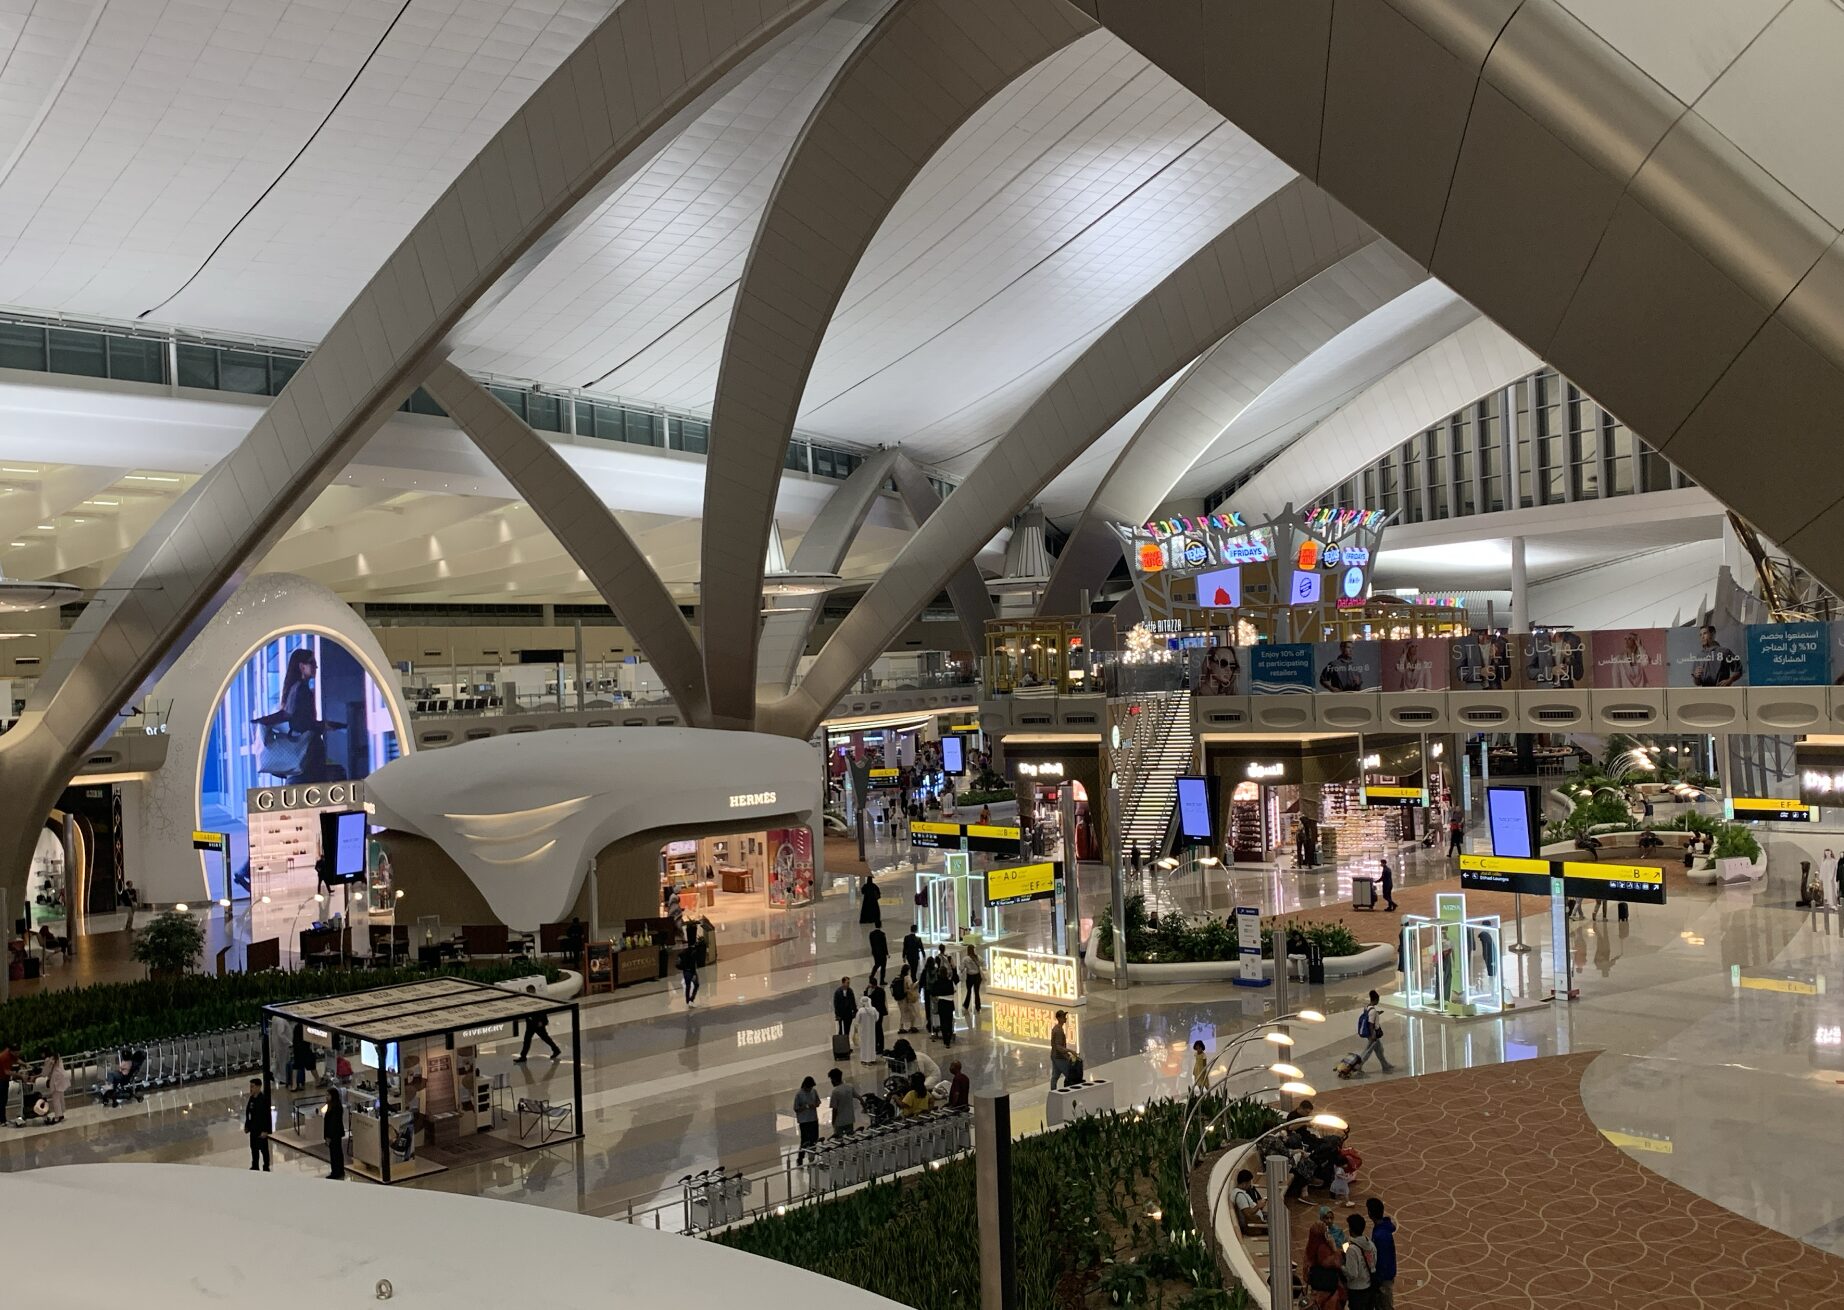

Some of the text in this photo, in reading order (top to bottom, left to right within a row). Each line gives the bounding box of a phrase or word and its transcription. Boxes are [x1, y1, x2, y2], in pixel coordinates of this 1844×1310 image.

[1147, 511, 1246, 537] FOOD PARK
[1233, 548, 1263, 557] FRIDAYS
[1261, 651, 1279, 659] Enjoy
[1716, 652, 1723, 661] 8
[1726, 654, 1740, 663] من
[1266, 660, 1309, 669] participating
[1327, 664, 1370, 673] From Aug 8
[1270, 669, 1298, 677] retailers
[1460, 665, 1509, 682] FEST
[257, 783, 357, 811] GUCCI
[1480, 859, 1487, 868] C
[1004, 871, 1017, 880] A D
[1633, 869, 1640, 878] B
[994, 955, 1073, 983] #CHECKINTO
[994, 973, 1075, 998] SUMMERSTYLE
[462, 1023, 504, 1038] GIVENCHY
